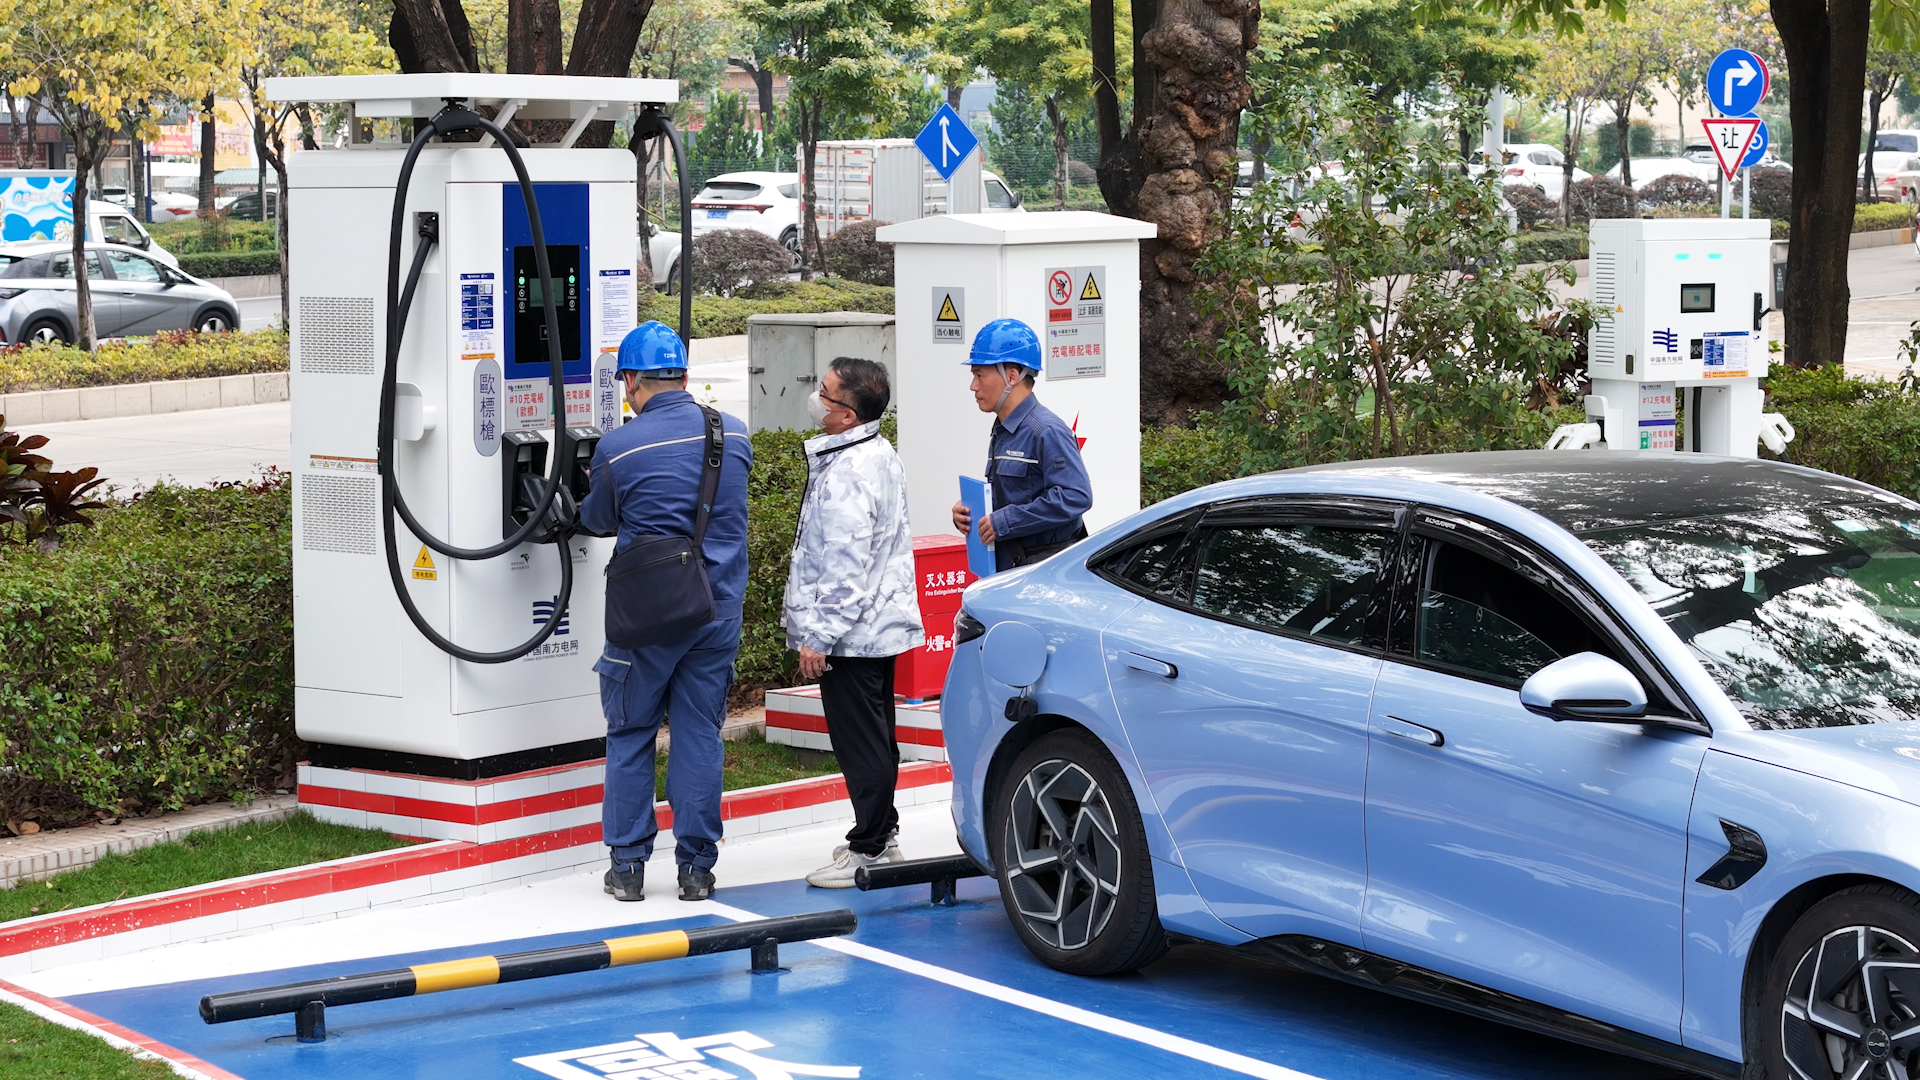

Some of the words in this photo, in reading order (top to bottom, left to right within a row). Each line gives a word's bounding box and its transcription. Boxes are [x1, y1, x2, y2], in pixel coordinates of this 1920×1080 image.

[1720, 127, 1739, 149] 让
[936, 328, 961, 337] 当心触电
[925, 570, 966, 588] 灭火器箱
[934, 588, 957, 596] Extinguisher
[526, 639, 579, 657] 国南方电网
